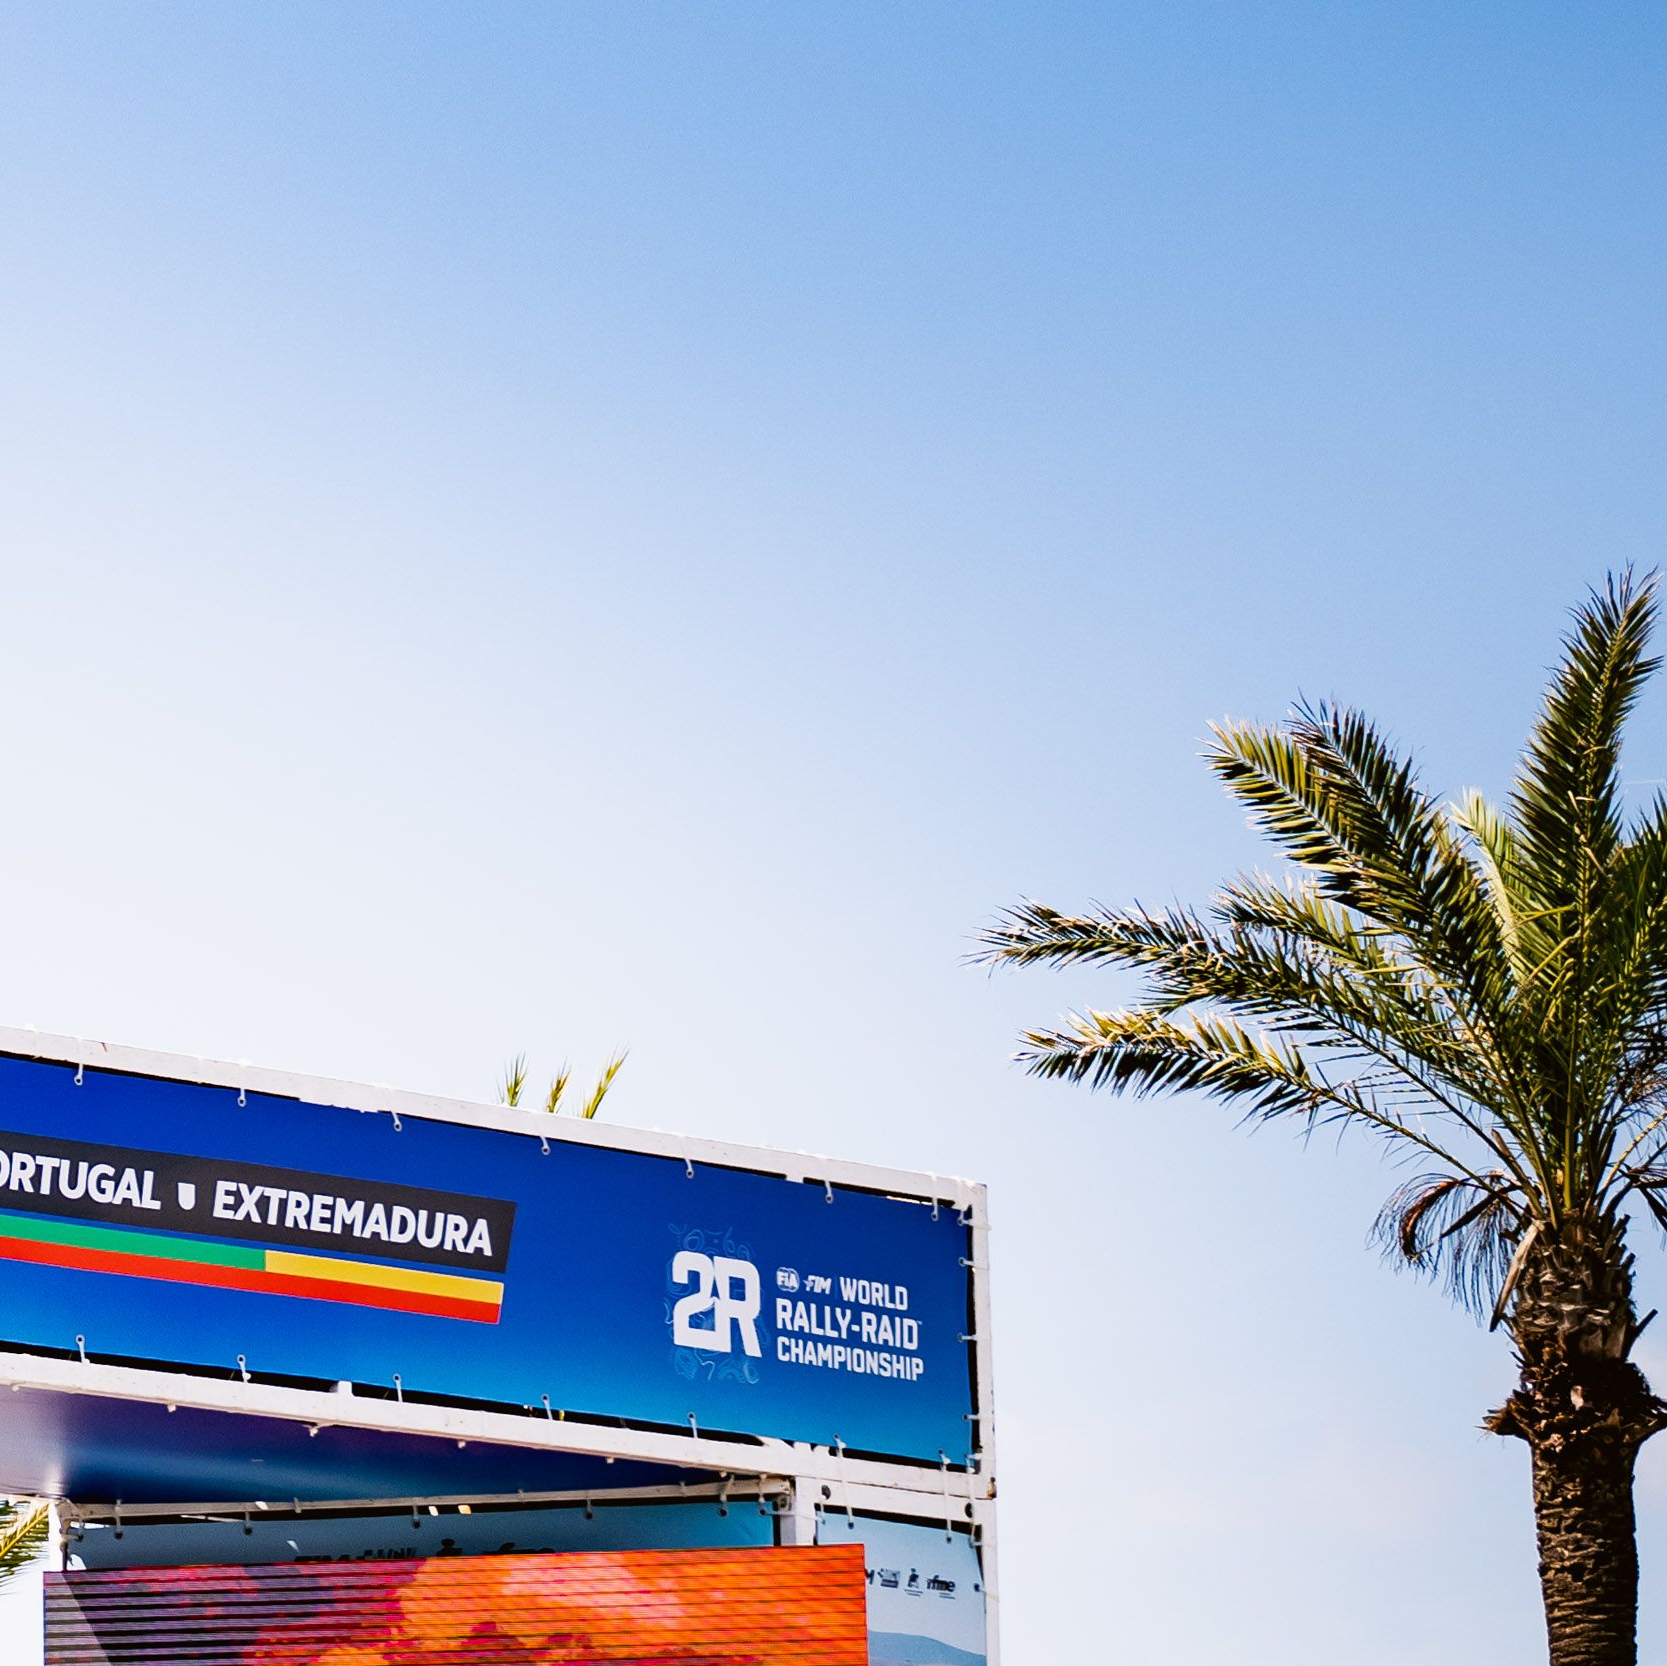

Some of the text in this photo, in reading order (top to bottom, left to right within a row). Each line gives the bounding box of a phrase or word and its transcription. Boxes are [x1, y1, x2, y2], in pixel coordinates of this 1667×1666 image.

[212, 1180, 494, 1258] EXTREMADURA
[671, 1250, 763, 1358] 2R
[839, 1276, 909, 1311] WORLD
[775, 1297, 919, 1351] RALLY-RAID
[776, 1335, 925, 1382] CHAMPIONSHIP
